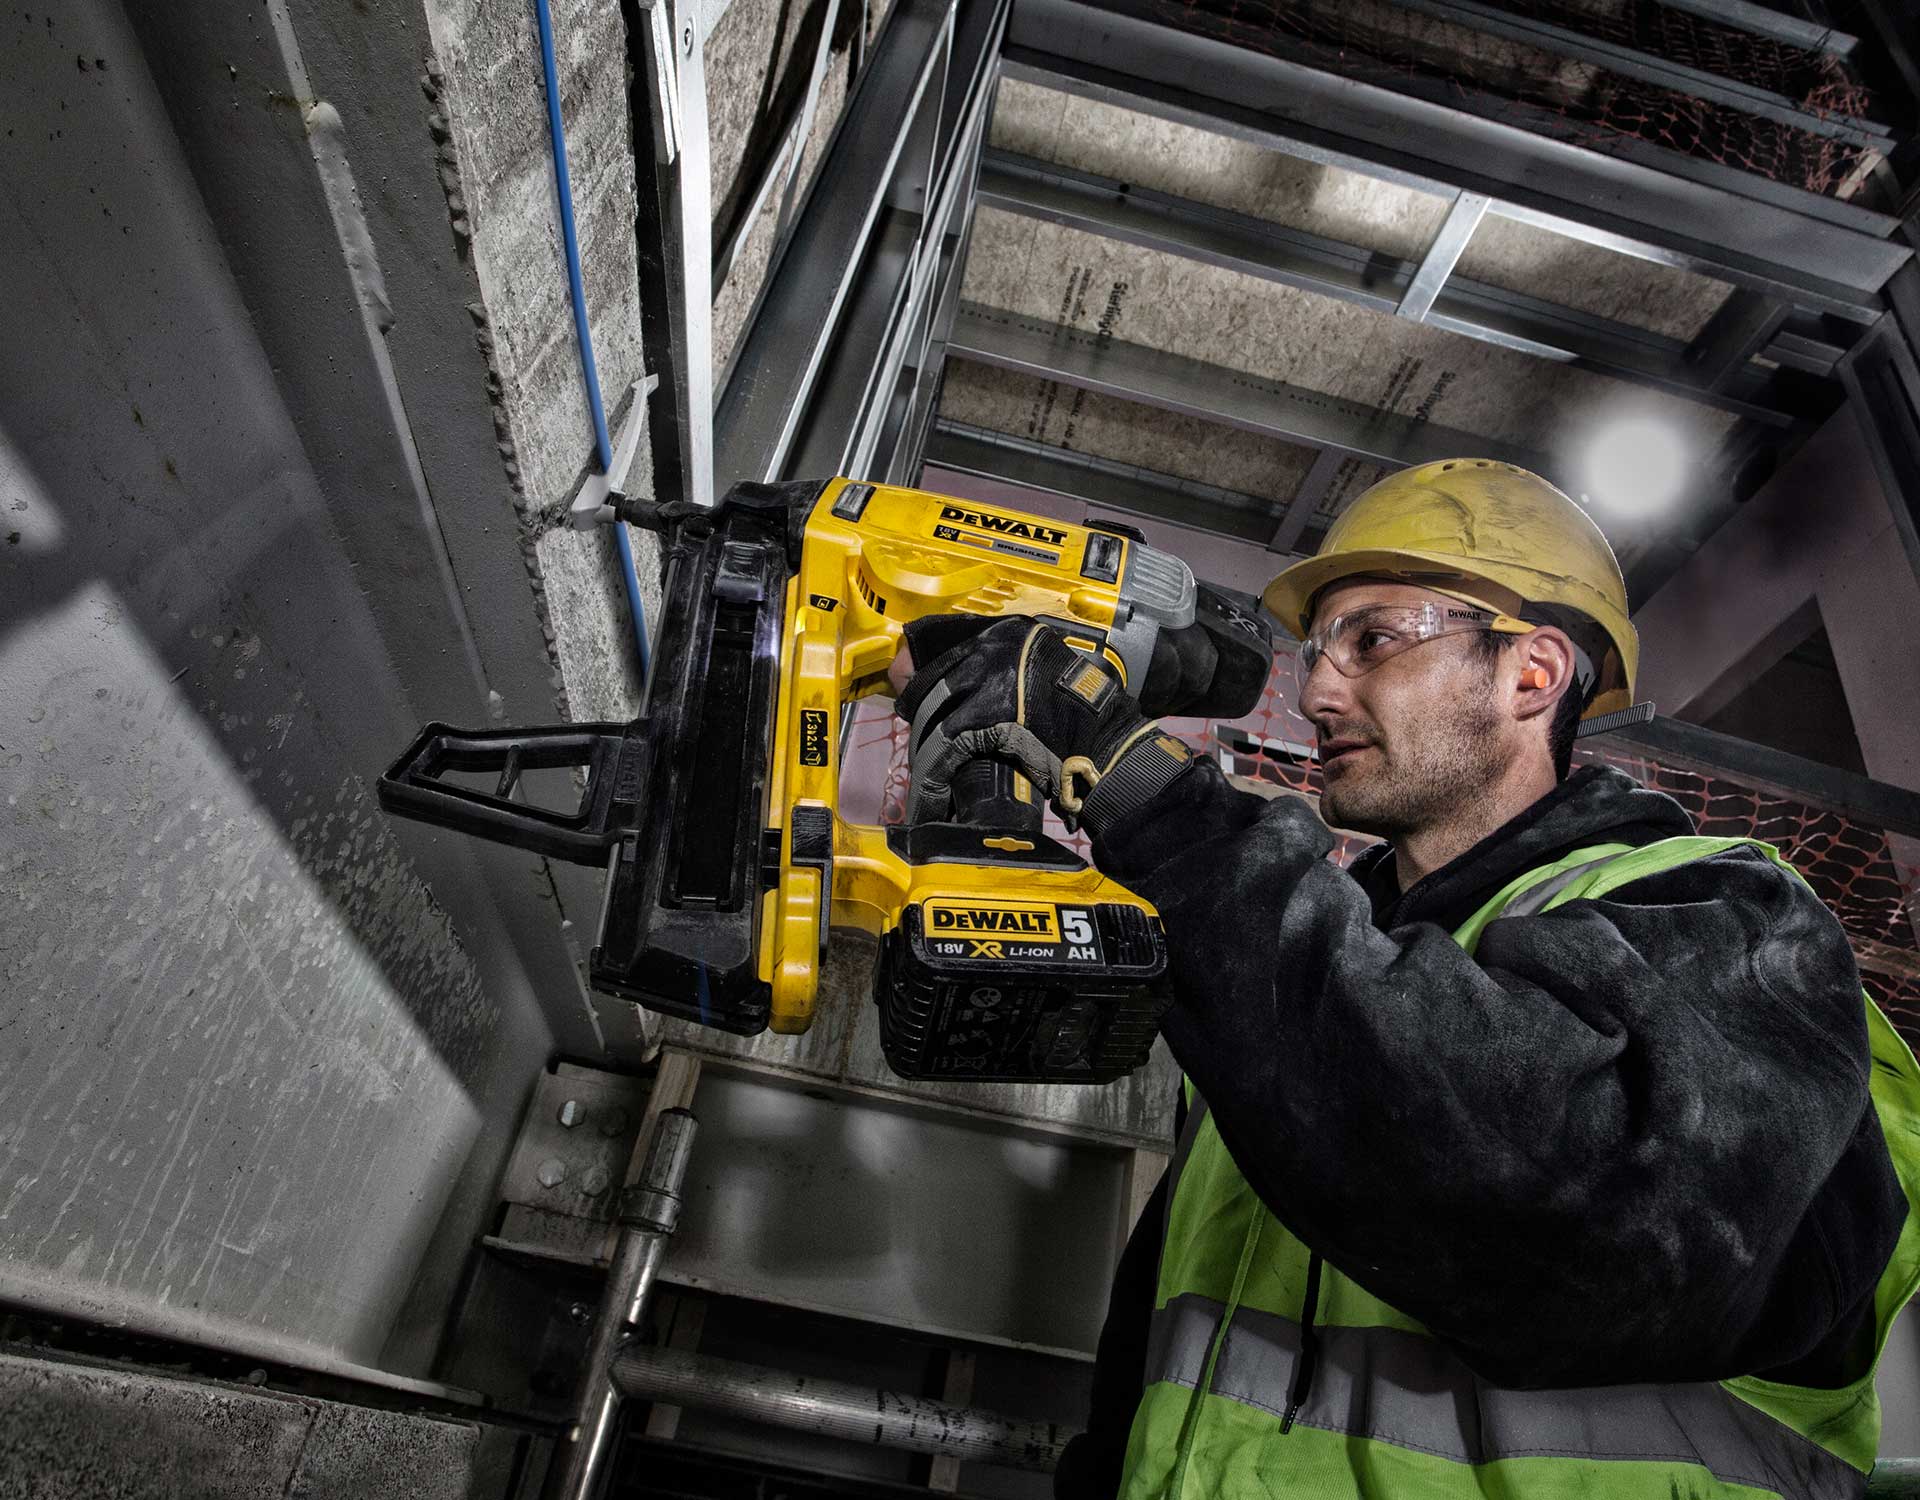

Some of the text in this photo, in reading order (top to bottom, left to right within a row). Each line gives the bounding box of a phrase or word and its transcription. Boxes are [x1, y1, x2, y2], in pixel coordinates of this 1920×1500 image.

[940, 506, 1068, 544] DEWALT
[932, 909, 1052, 932] DEWALT
[1061, 910, 1094, 944] 5
[935, 940, 1054, 959] 18V XR LI-ION
[1067, 947, 1098, 961] AH
